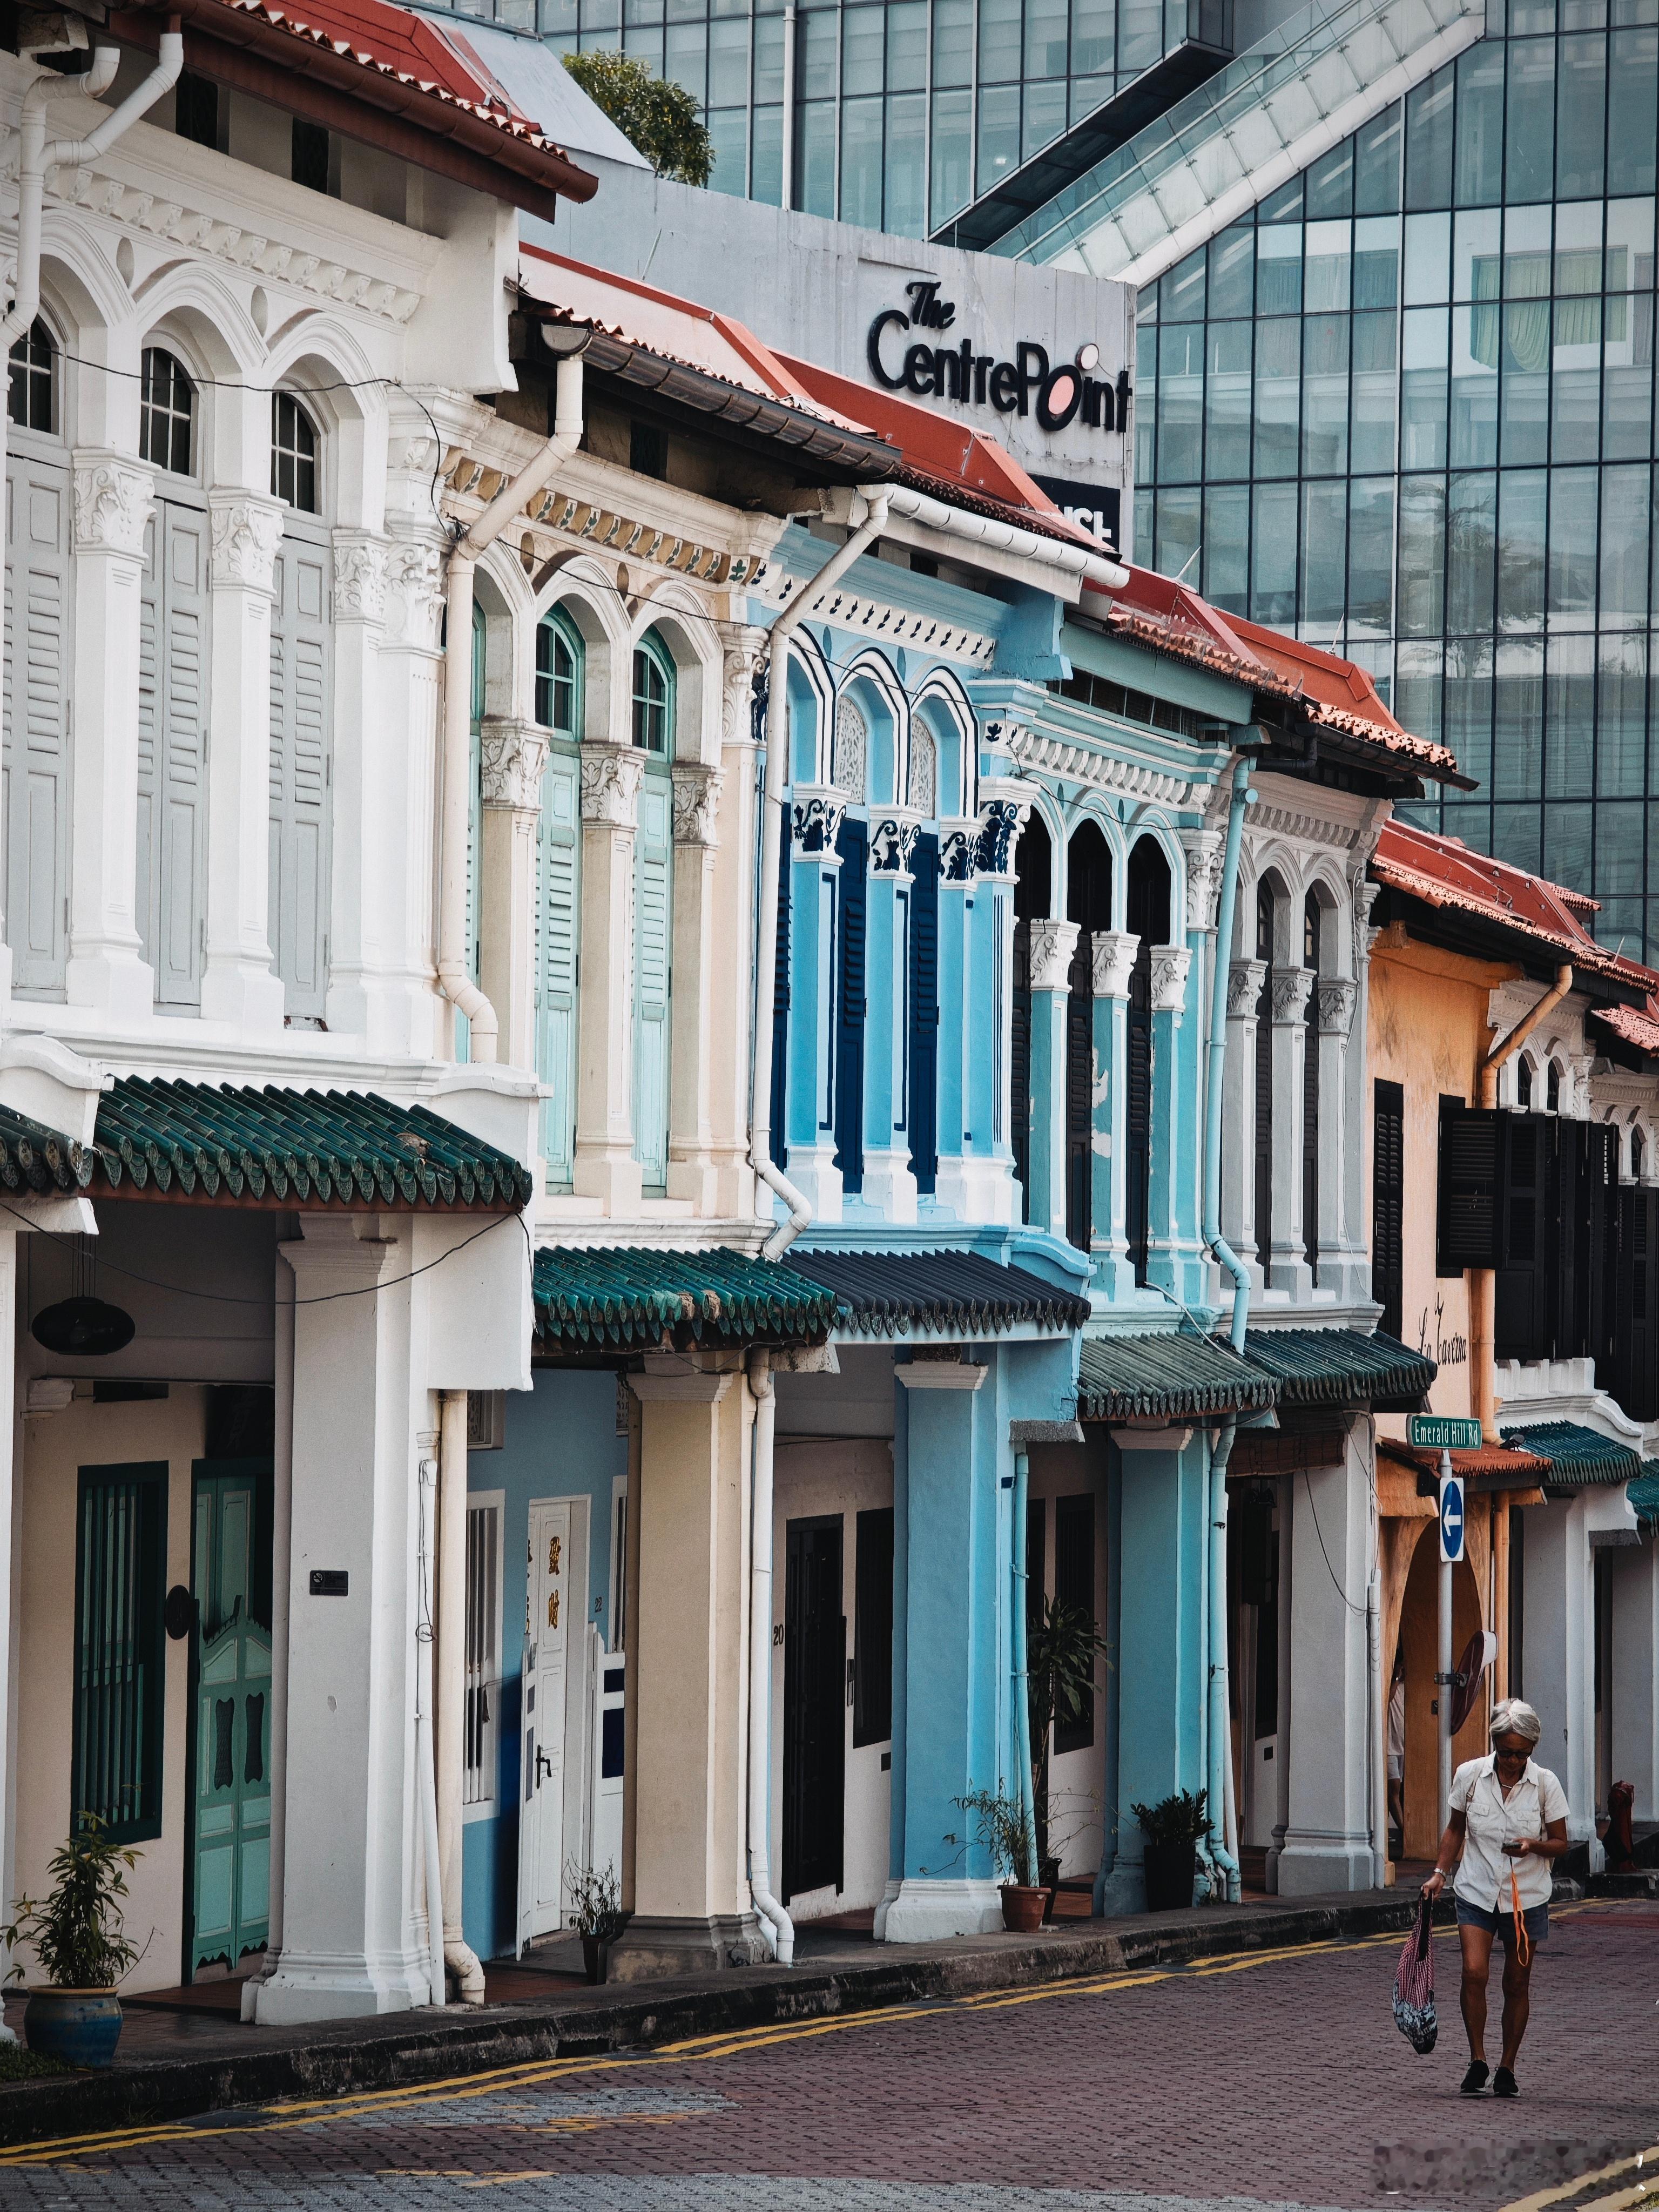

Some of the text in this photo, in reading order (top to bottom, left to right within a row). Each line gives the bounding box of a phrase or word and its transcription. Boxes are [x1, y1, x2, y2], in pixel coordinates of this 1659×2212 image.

[907, 281, 956, 329] The
[1434, 1291, 1467, 1366] Taverna
[1415, 1420, 1478, 1446] Emerald Hill Rd
[595, 1596, 602, 1613] 22
[773, 1624, 784, 1646] 20
